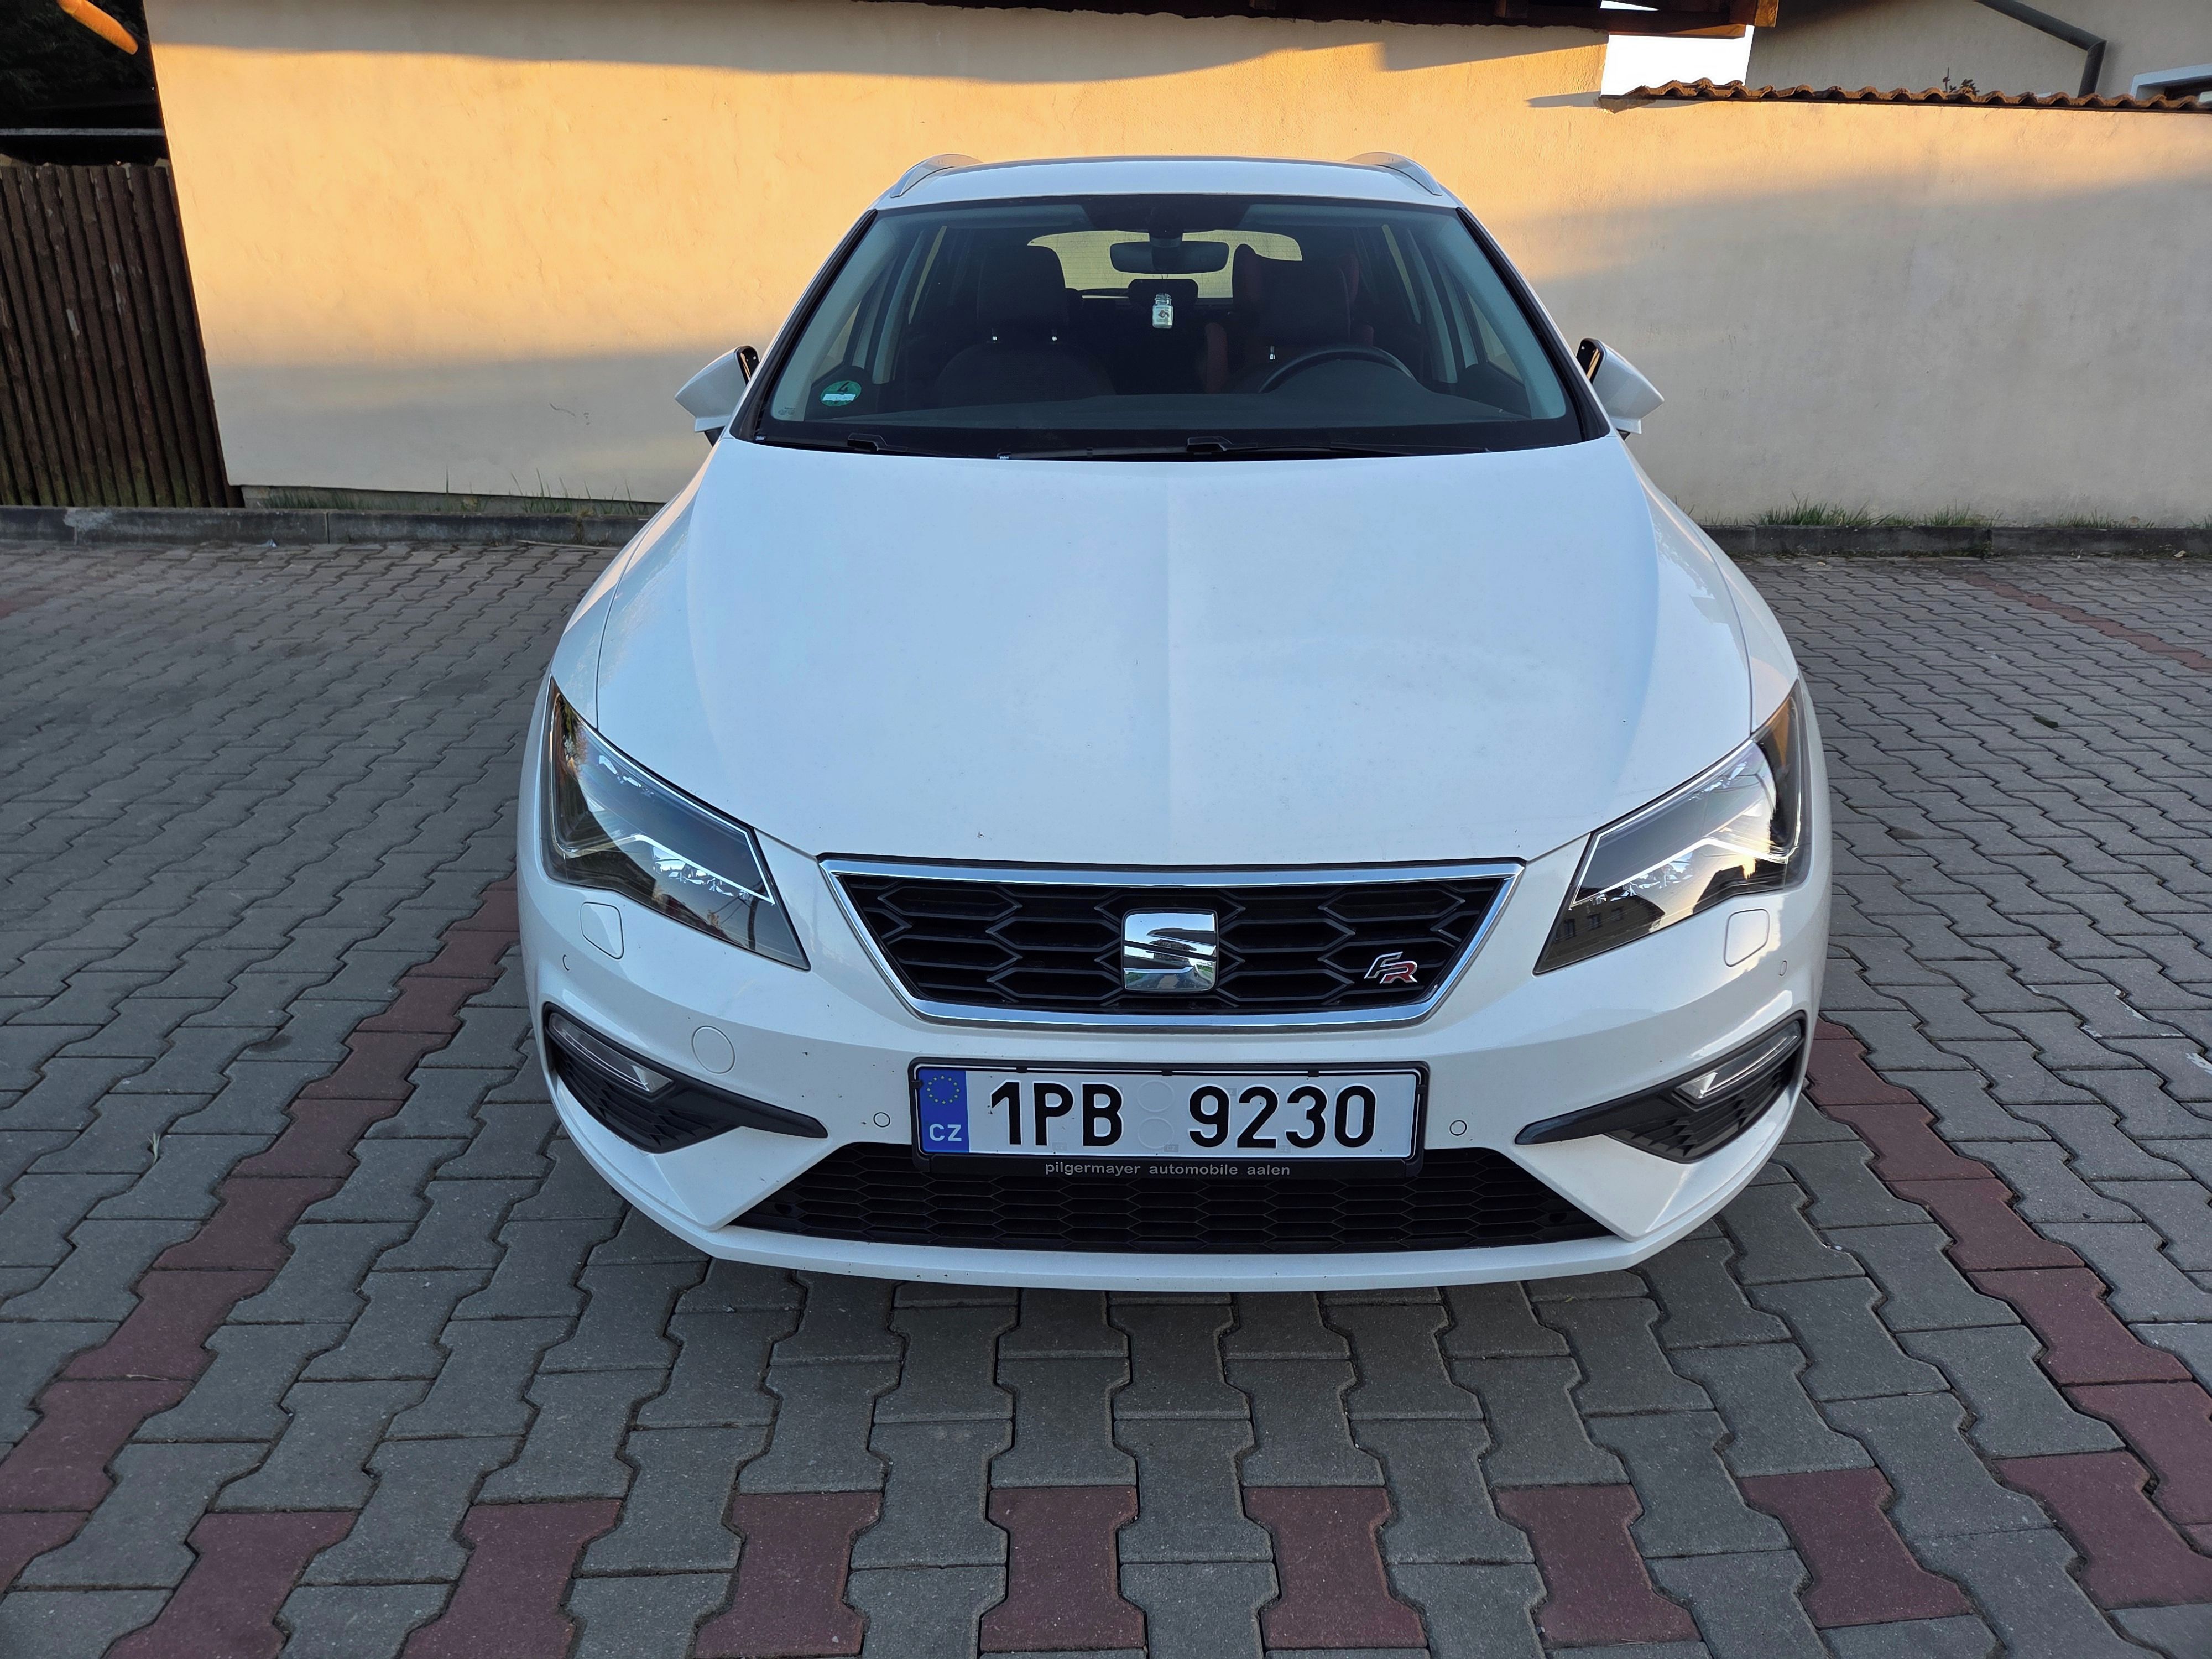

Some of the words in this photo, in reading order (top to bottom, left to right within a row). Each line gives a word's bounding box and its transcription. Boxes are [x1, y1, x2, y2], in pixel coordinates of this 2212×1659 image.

[1364, 951, 1418, 984] FR
[991, 1081, 1122, 1146] 1PB
[1189, 1085, 1376, 1149] 9230
[929, 1123, 962, 1142] CZ
[1045, 1161, 1141, 1176] pilgermayer
[1149, 1164, 1238, 1175] automobile
[1247, 1164, 1290, 1175] aalen
